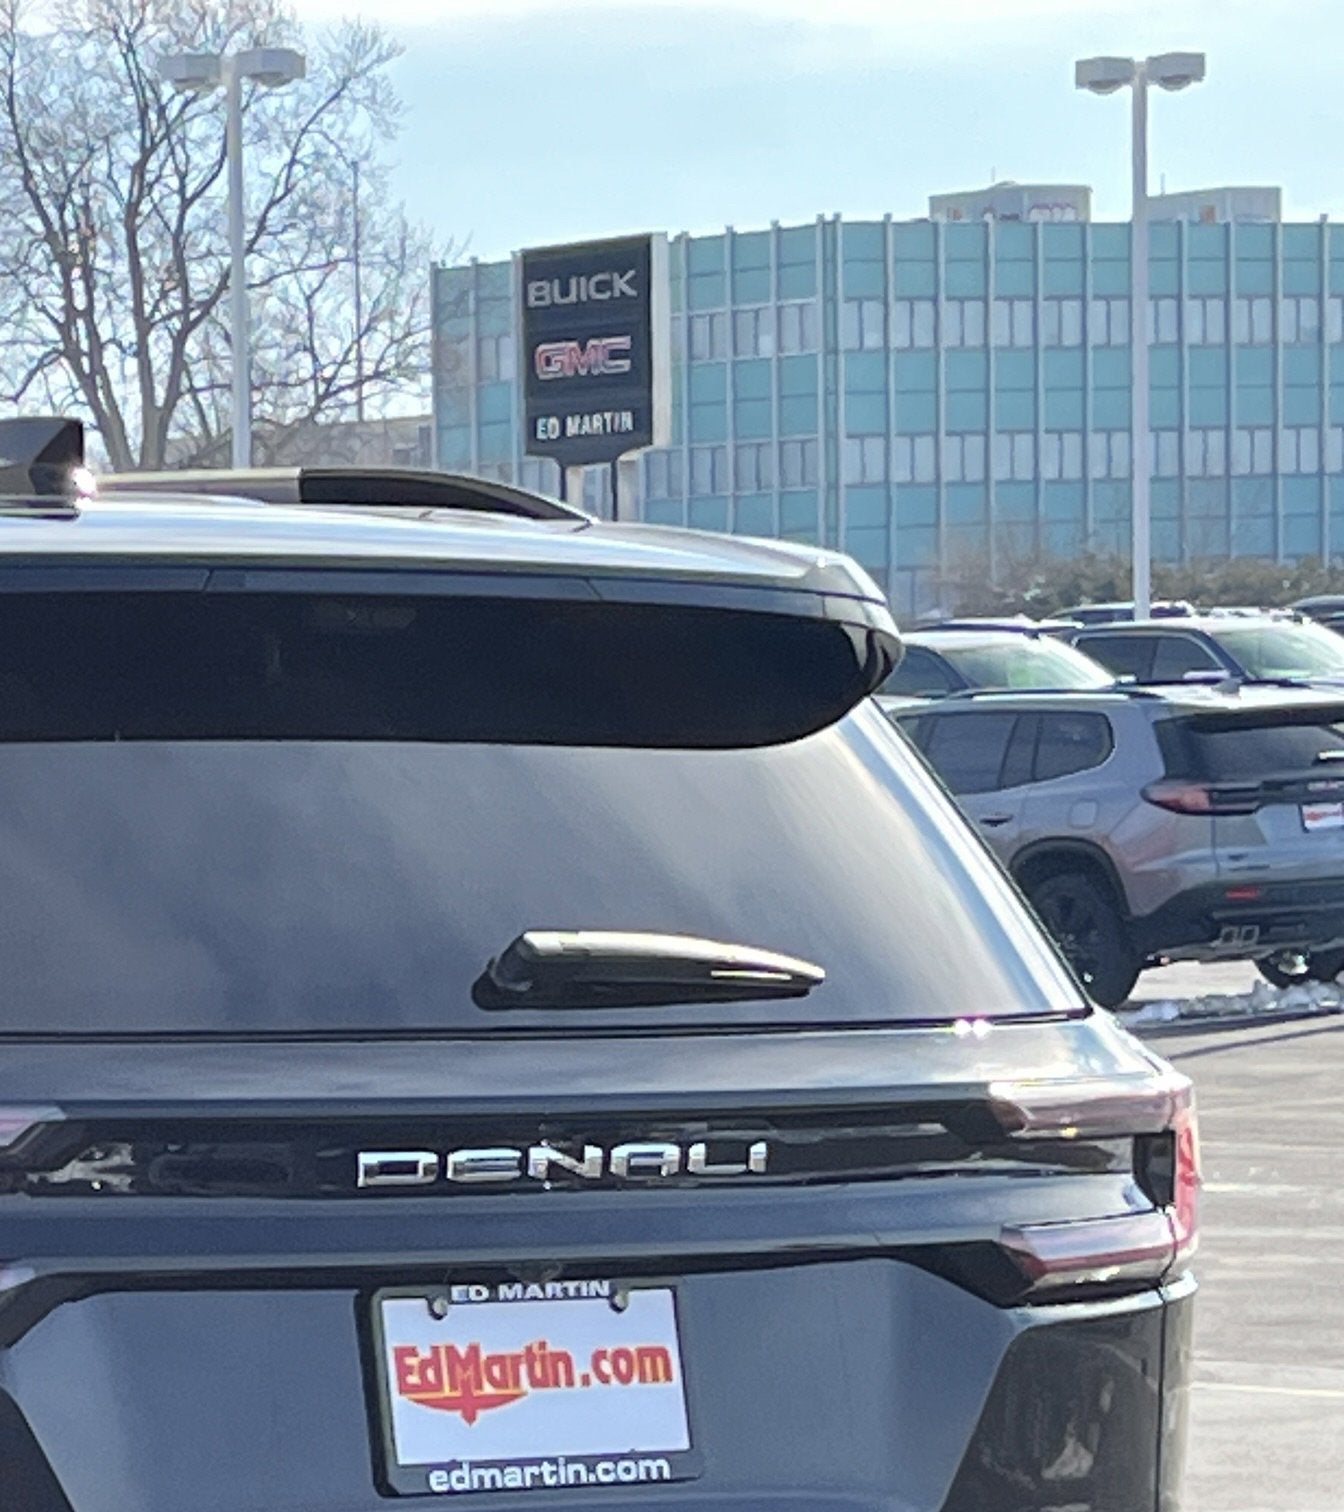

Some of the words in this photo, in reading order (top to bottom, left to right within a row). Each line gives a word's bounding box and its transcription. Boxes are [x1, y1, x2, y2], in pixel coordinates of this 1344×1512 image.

[527, 270, 637, 307] BUICK
[536, 336, 631, 380] GMC
[536, 415, 560, 440] ED
[566, 411, 633, 437] MARTIN
[356, 1141, 767, 1188] DENALI
[451, 1284, 490, 1301] ED
[498, 1280, 610, 1300] MARTIN
[393, 1338, 673, 1395] EdMartin.com
[429, 1457, 671, 1493] edmartin.com
